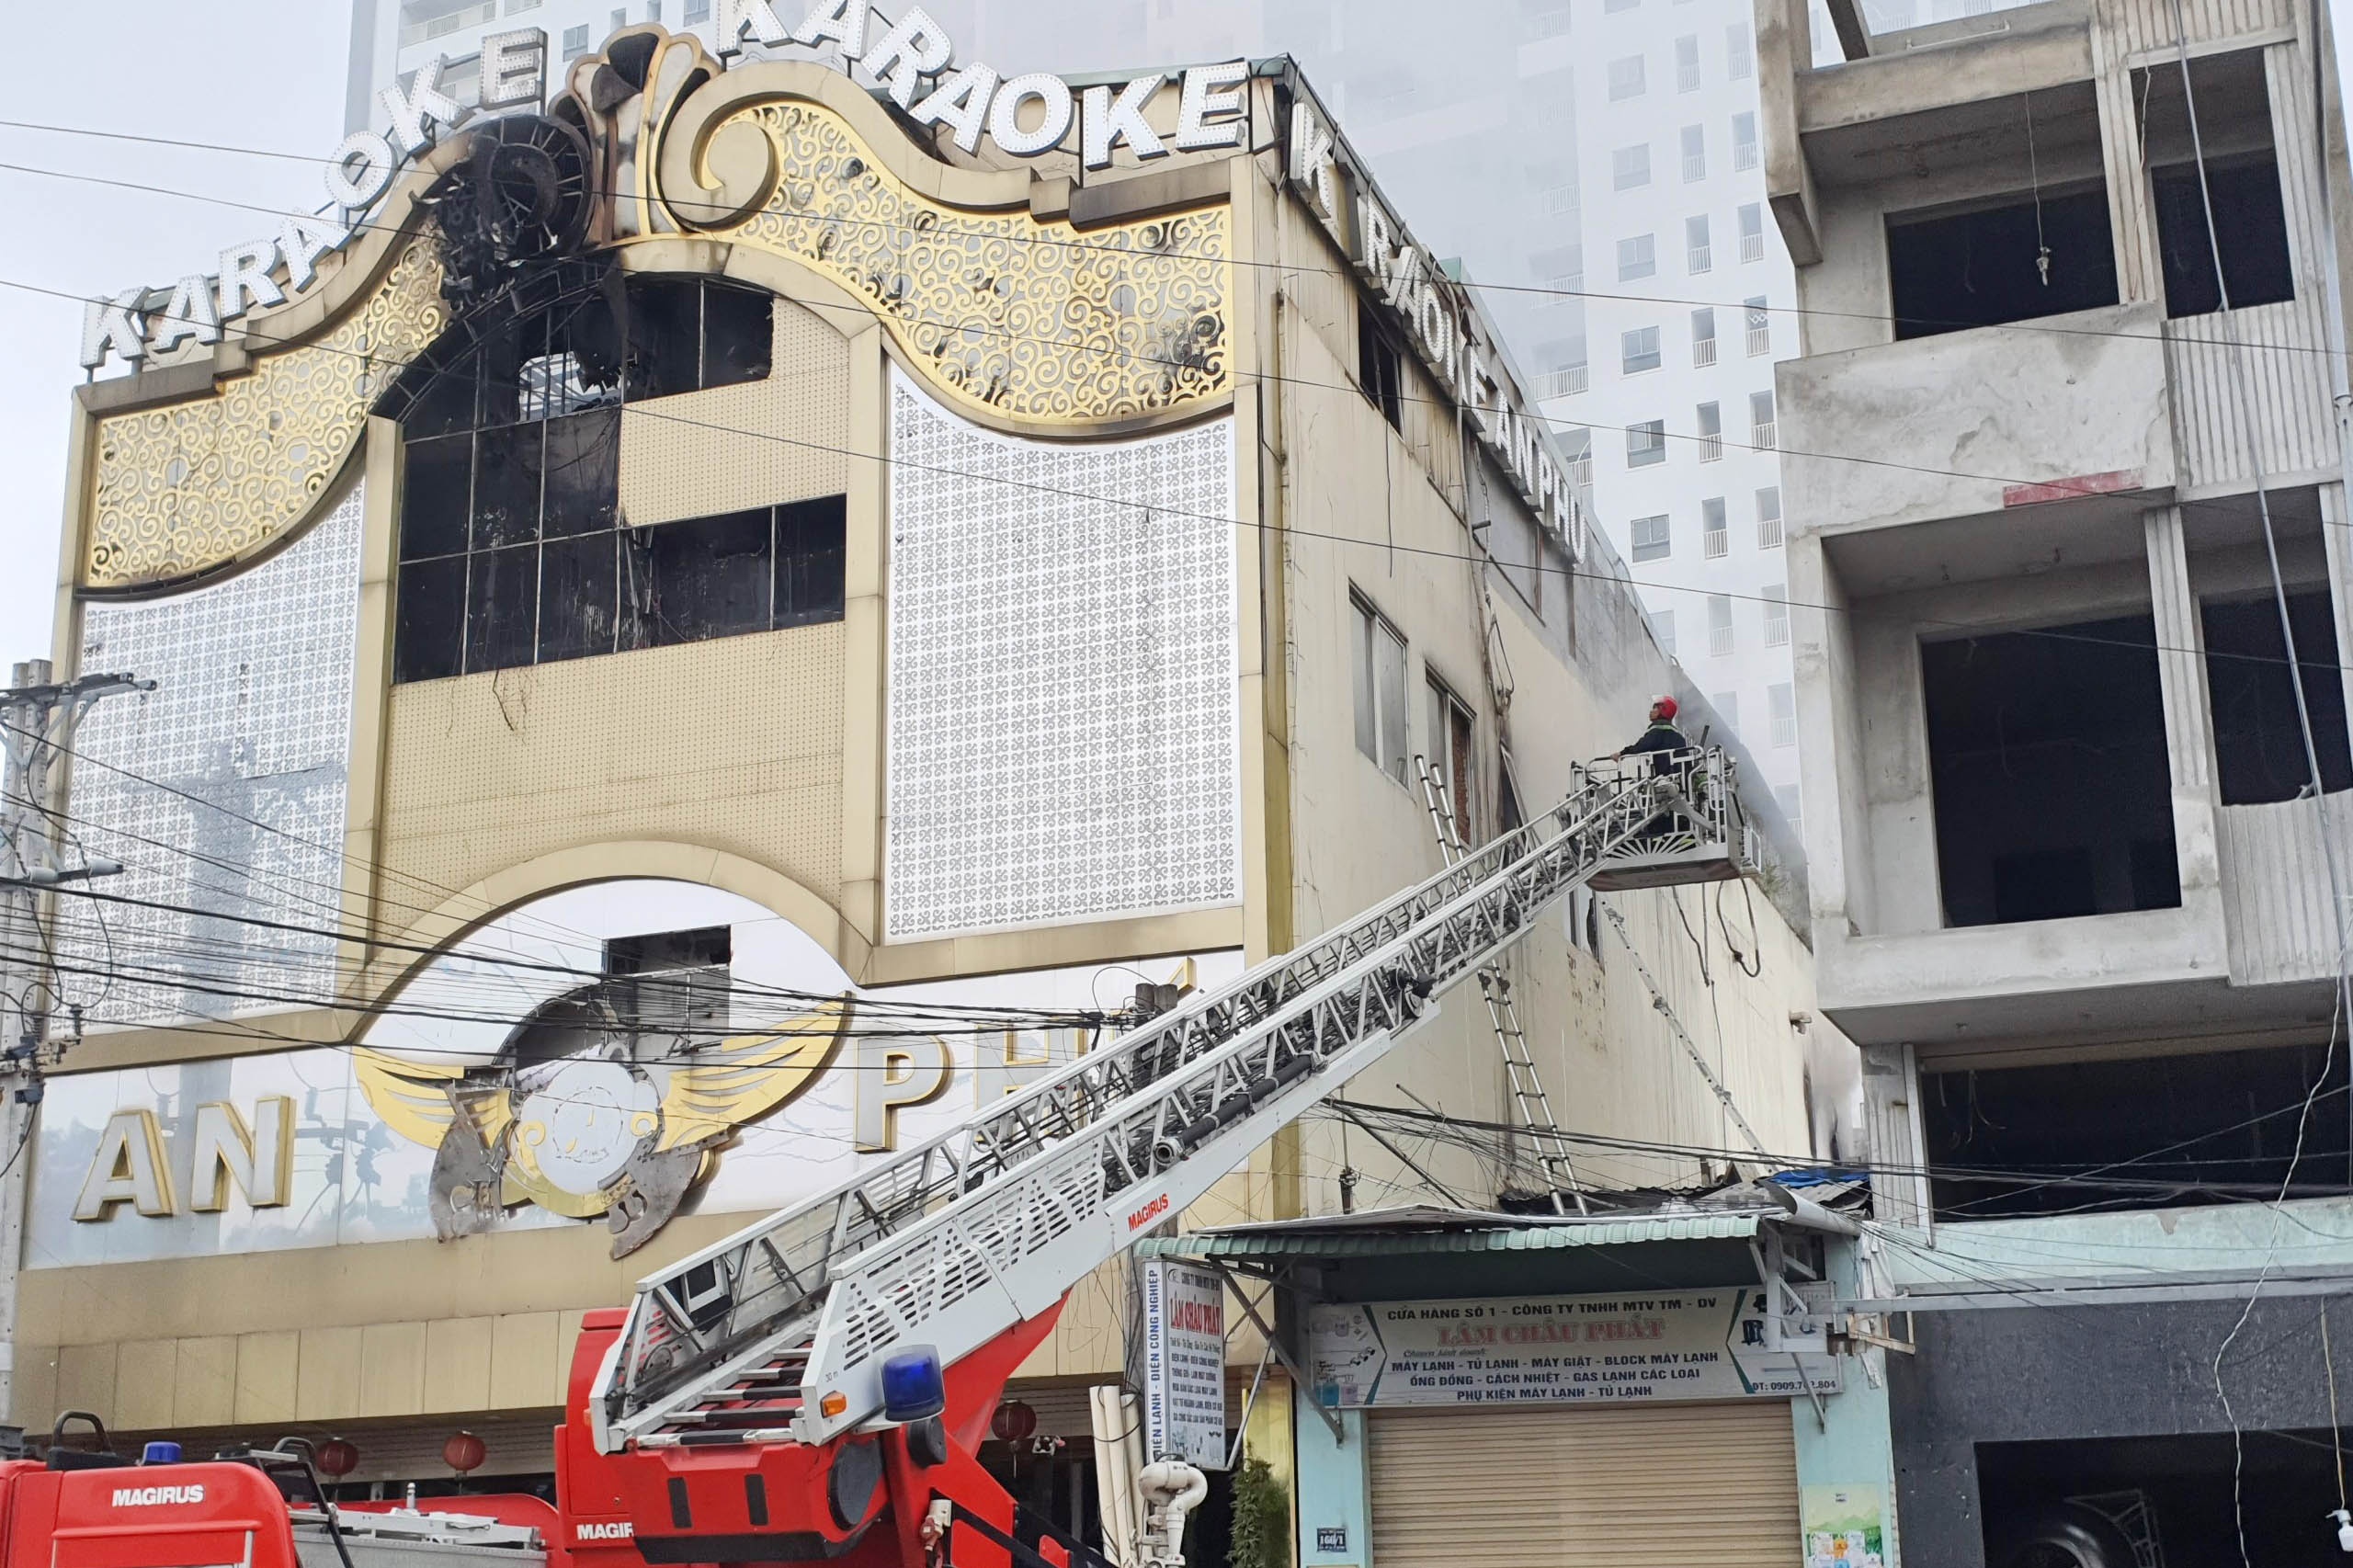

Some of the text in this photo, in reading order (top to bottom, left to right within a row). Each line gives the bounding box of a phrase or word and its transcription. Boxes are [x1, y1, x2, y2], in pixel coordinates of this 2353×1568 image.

[716, 0, 1251, 170] KARAOKE
[80, 27, 548, 369] KARAOKE
[71, 1096, 296, 1222] AN
[1128, 1193, 1168, 1233] MAGIRUS
[1388, 1305, 1415, 1320] CỬA
[1421, 1306, 1460, 1319] HÀNG
[1465, 1303, 1483, 1318] SỐ
[1490, 1308, 1495, 1316] 1
[1512, 1303, 1552, 1315] CÔNG
[1557, 1303, 1574, 1313] TY
[1579, 1302, 1618, 1312] TNHH
[1623, 1301, 1654, 1312] MTV
[1659, 1300, 1681, 1310] TM
[1698, 1298, 1716, 1308] DV
[1148, 1317, 1160, 1349] CÔNG
[1392, 1360, 1417, 1372] MÁY
[1422, 1361, 1454, 1373] LẠNH
[1485, 1359, 1518, 1371] LẠNH
[1531, 1356, 1559, 1369] MÁY
[1605, 1355, 1646, 1366] BLOCK
[1651, 1352, 1678, 1364] MÁY
[1684, 1352, 1718, 1365] LẠNH
[1486, 1371, 1519, 1384] CÁCH
[1523, 1372, 1560, 1385] NHIỆT
[1574, 1372, 1597, 1381] GAS
[1603, 1370, 1636, 1383] LẠNH
[1641, 1368, 1666, 1380] CÁC
[1671, 1369, 1699, 1381] LOẠI
[1457, 1390, 1482, 1402] PHỤ
[1486, 1388, 1516, 1401] KIỆN
[1519, 1386, 1547, 1398] MÁY
[1552, 1388, 1586, 1401] LẠNH
[1618, 1386, 1653, 1399] LẠNH
[112, 1484, 204, 1507] MAGIRUS
